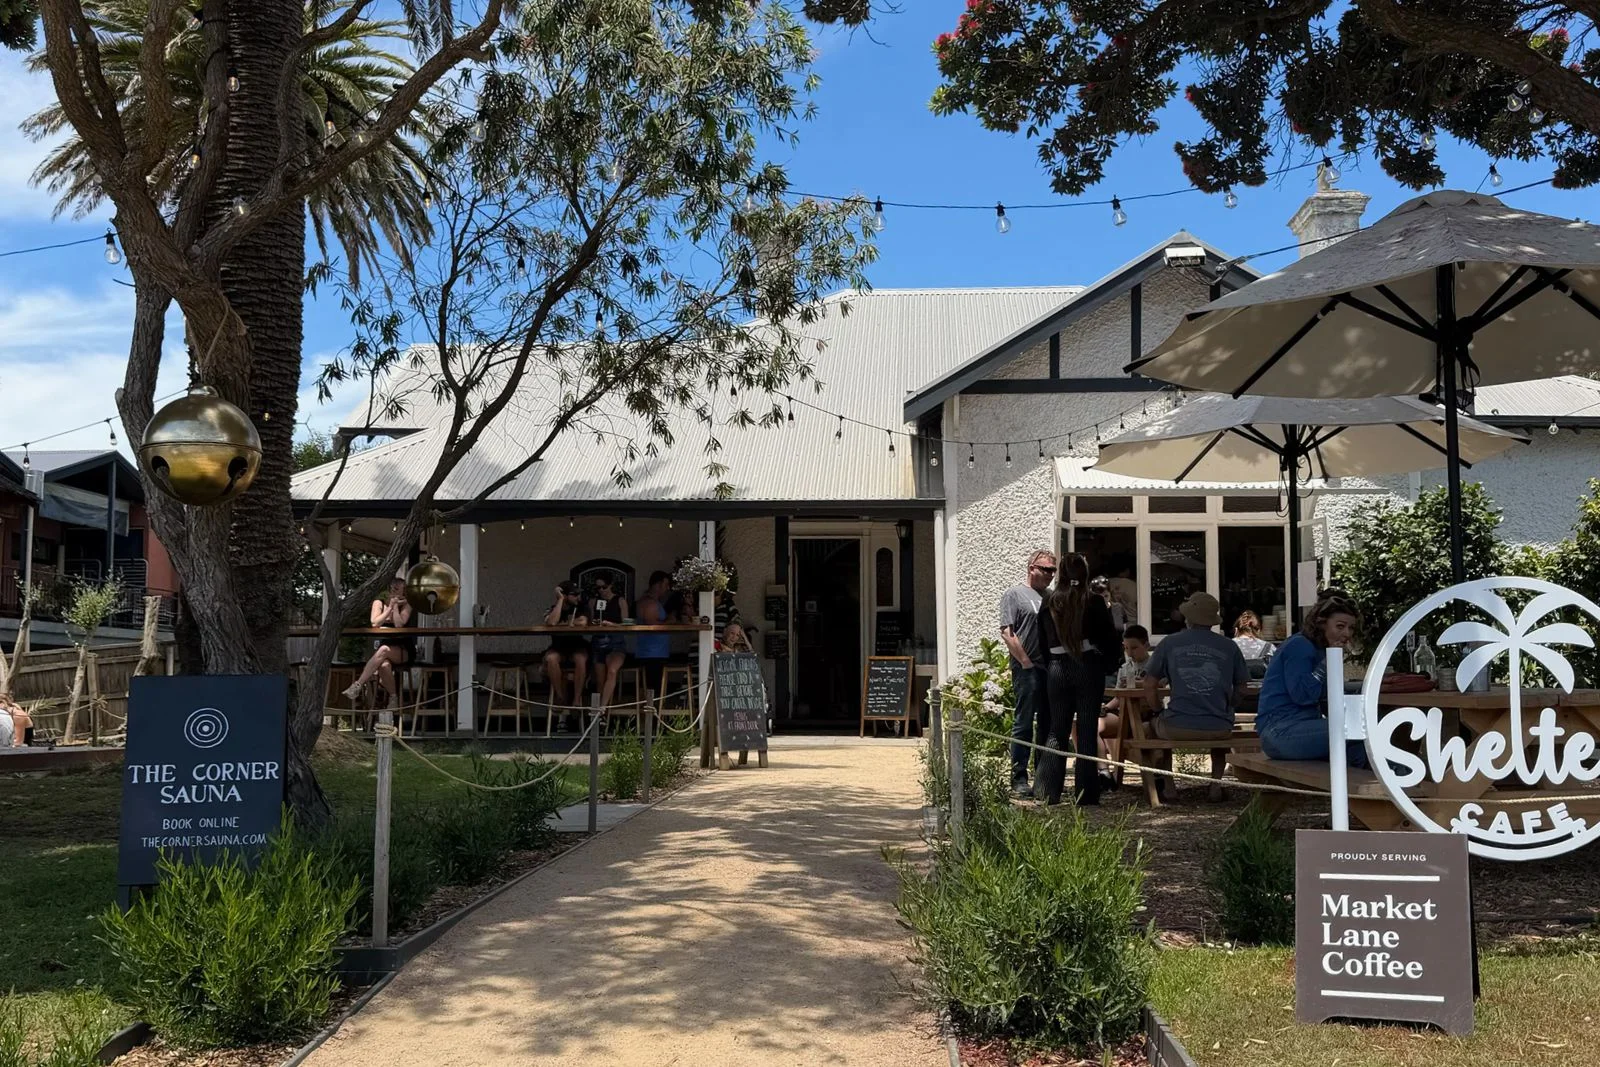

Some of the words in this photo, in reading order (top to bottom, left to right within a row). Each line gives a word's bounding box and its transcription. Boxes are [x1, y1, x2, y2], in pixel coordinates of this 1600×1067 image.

[1377, 706, 1600, 788] Shelte
[127, 764, 176, 784] THE
[192, 761, 279, 781] CORNER
[160, 784, 242, 804] SAUNA
[162, 818, 192, 831] BOOK
[199, 816, 240, 828] ONLINE
[1458, 801, 1573, 836] CAFE
[141, 833, 267, 848] THECORNERSAUNA.COM
[1330, 852, 1378, 861] PROUDLY
[1381, 853, 1427, 862] SERVING
[1321, 893, 1438, 920] Market
[1321, 922, 1400, 948] Lane
[1321, 951, 1424, 979] Coffee
